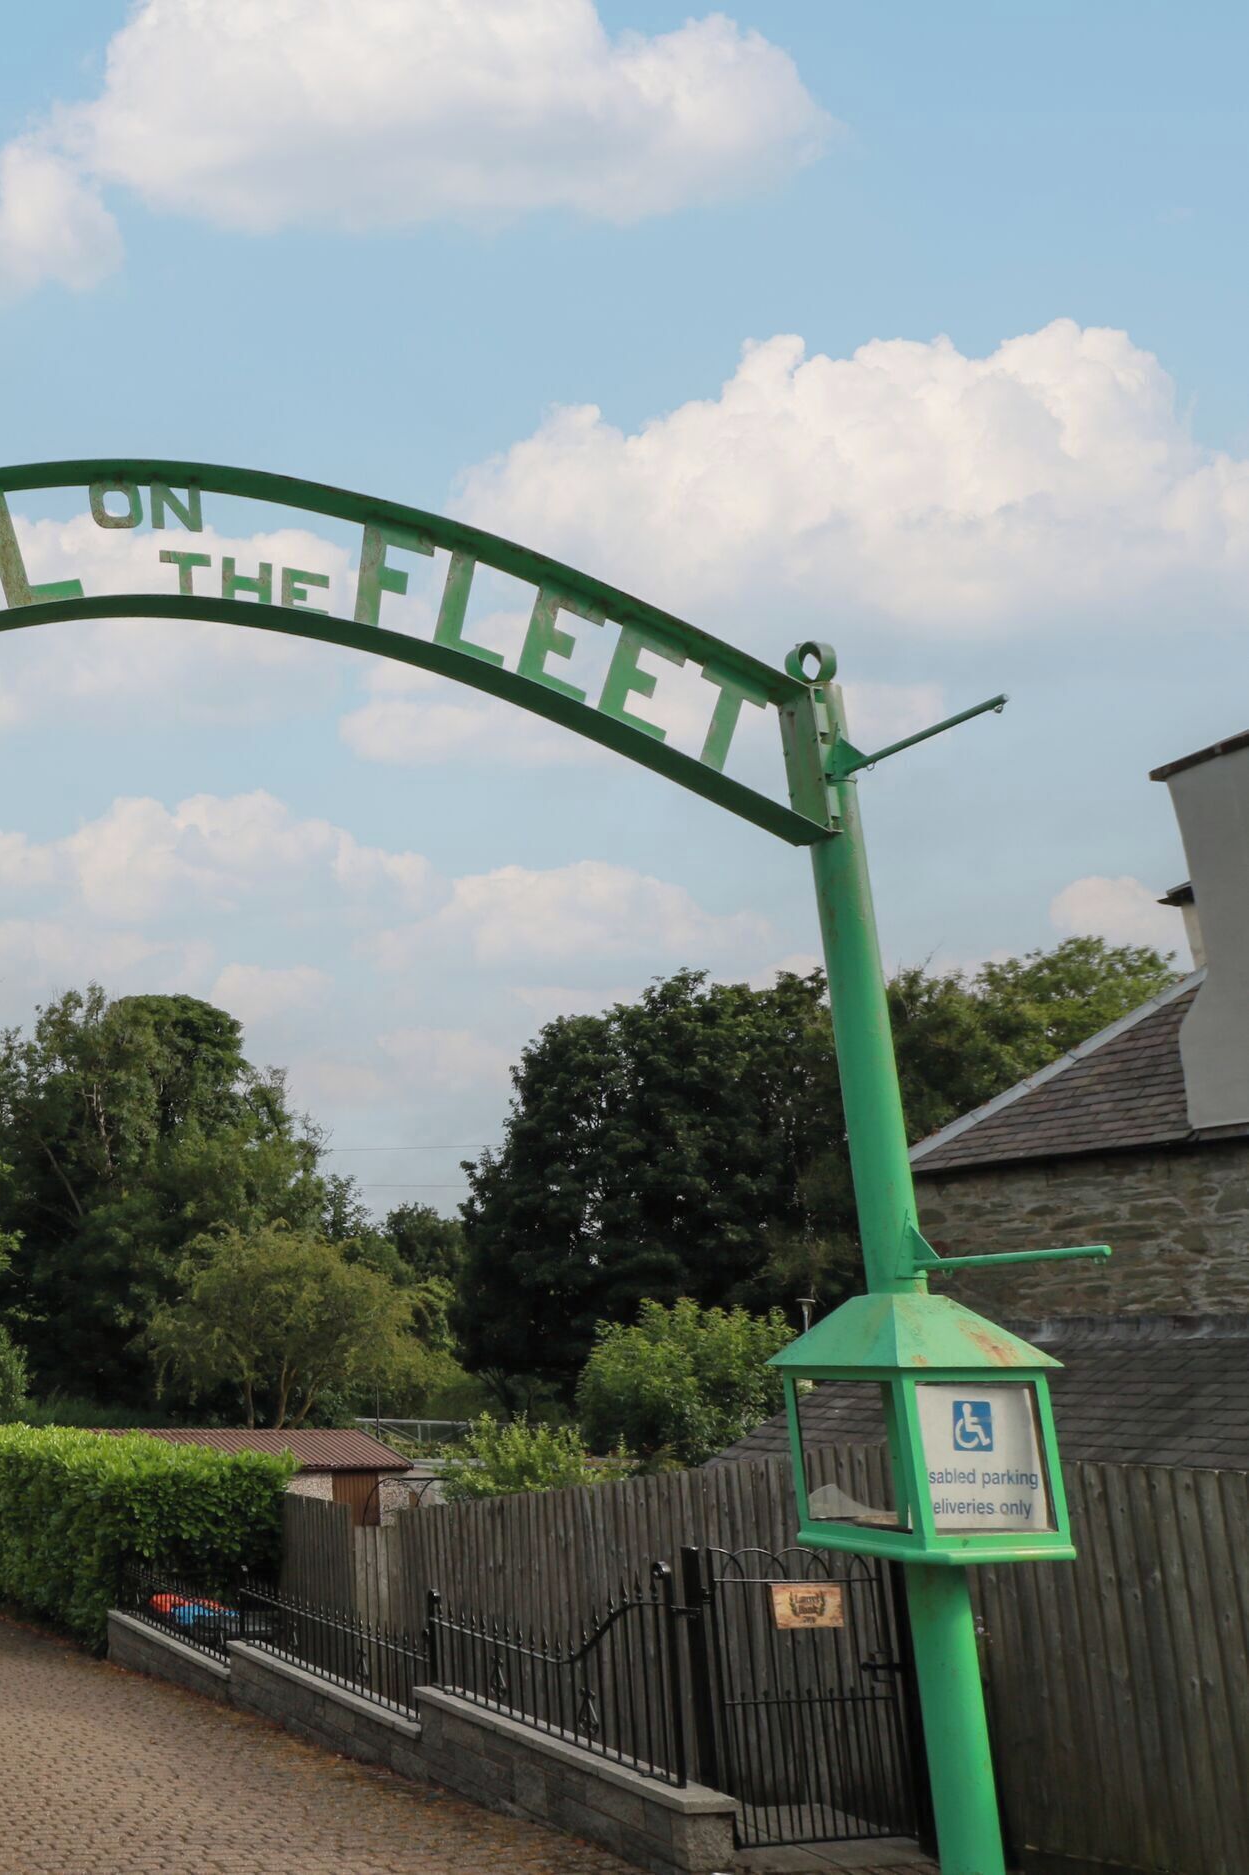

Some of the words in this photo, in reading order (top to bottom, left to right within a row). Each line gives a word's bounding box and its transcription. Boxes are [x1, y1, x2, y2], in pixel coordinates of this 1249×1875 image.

[88, 480, 204, 533] ON
[159, 550, 330, 616] THE
[353, 520, 769, 774] FLEET
[927, 1467, 976, 1484] sabled
[982, 1469, 1039, 1490] parking
[933, 1498, 995, 1515] eliveries
[999, 1500, 1032, 1519] only
